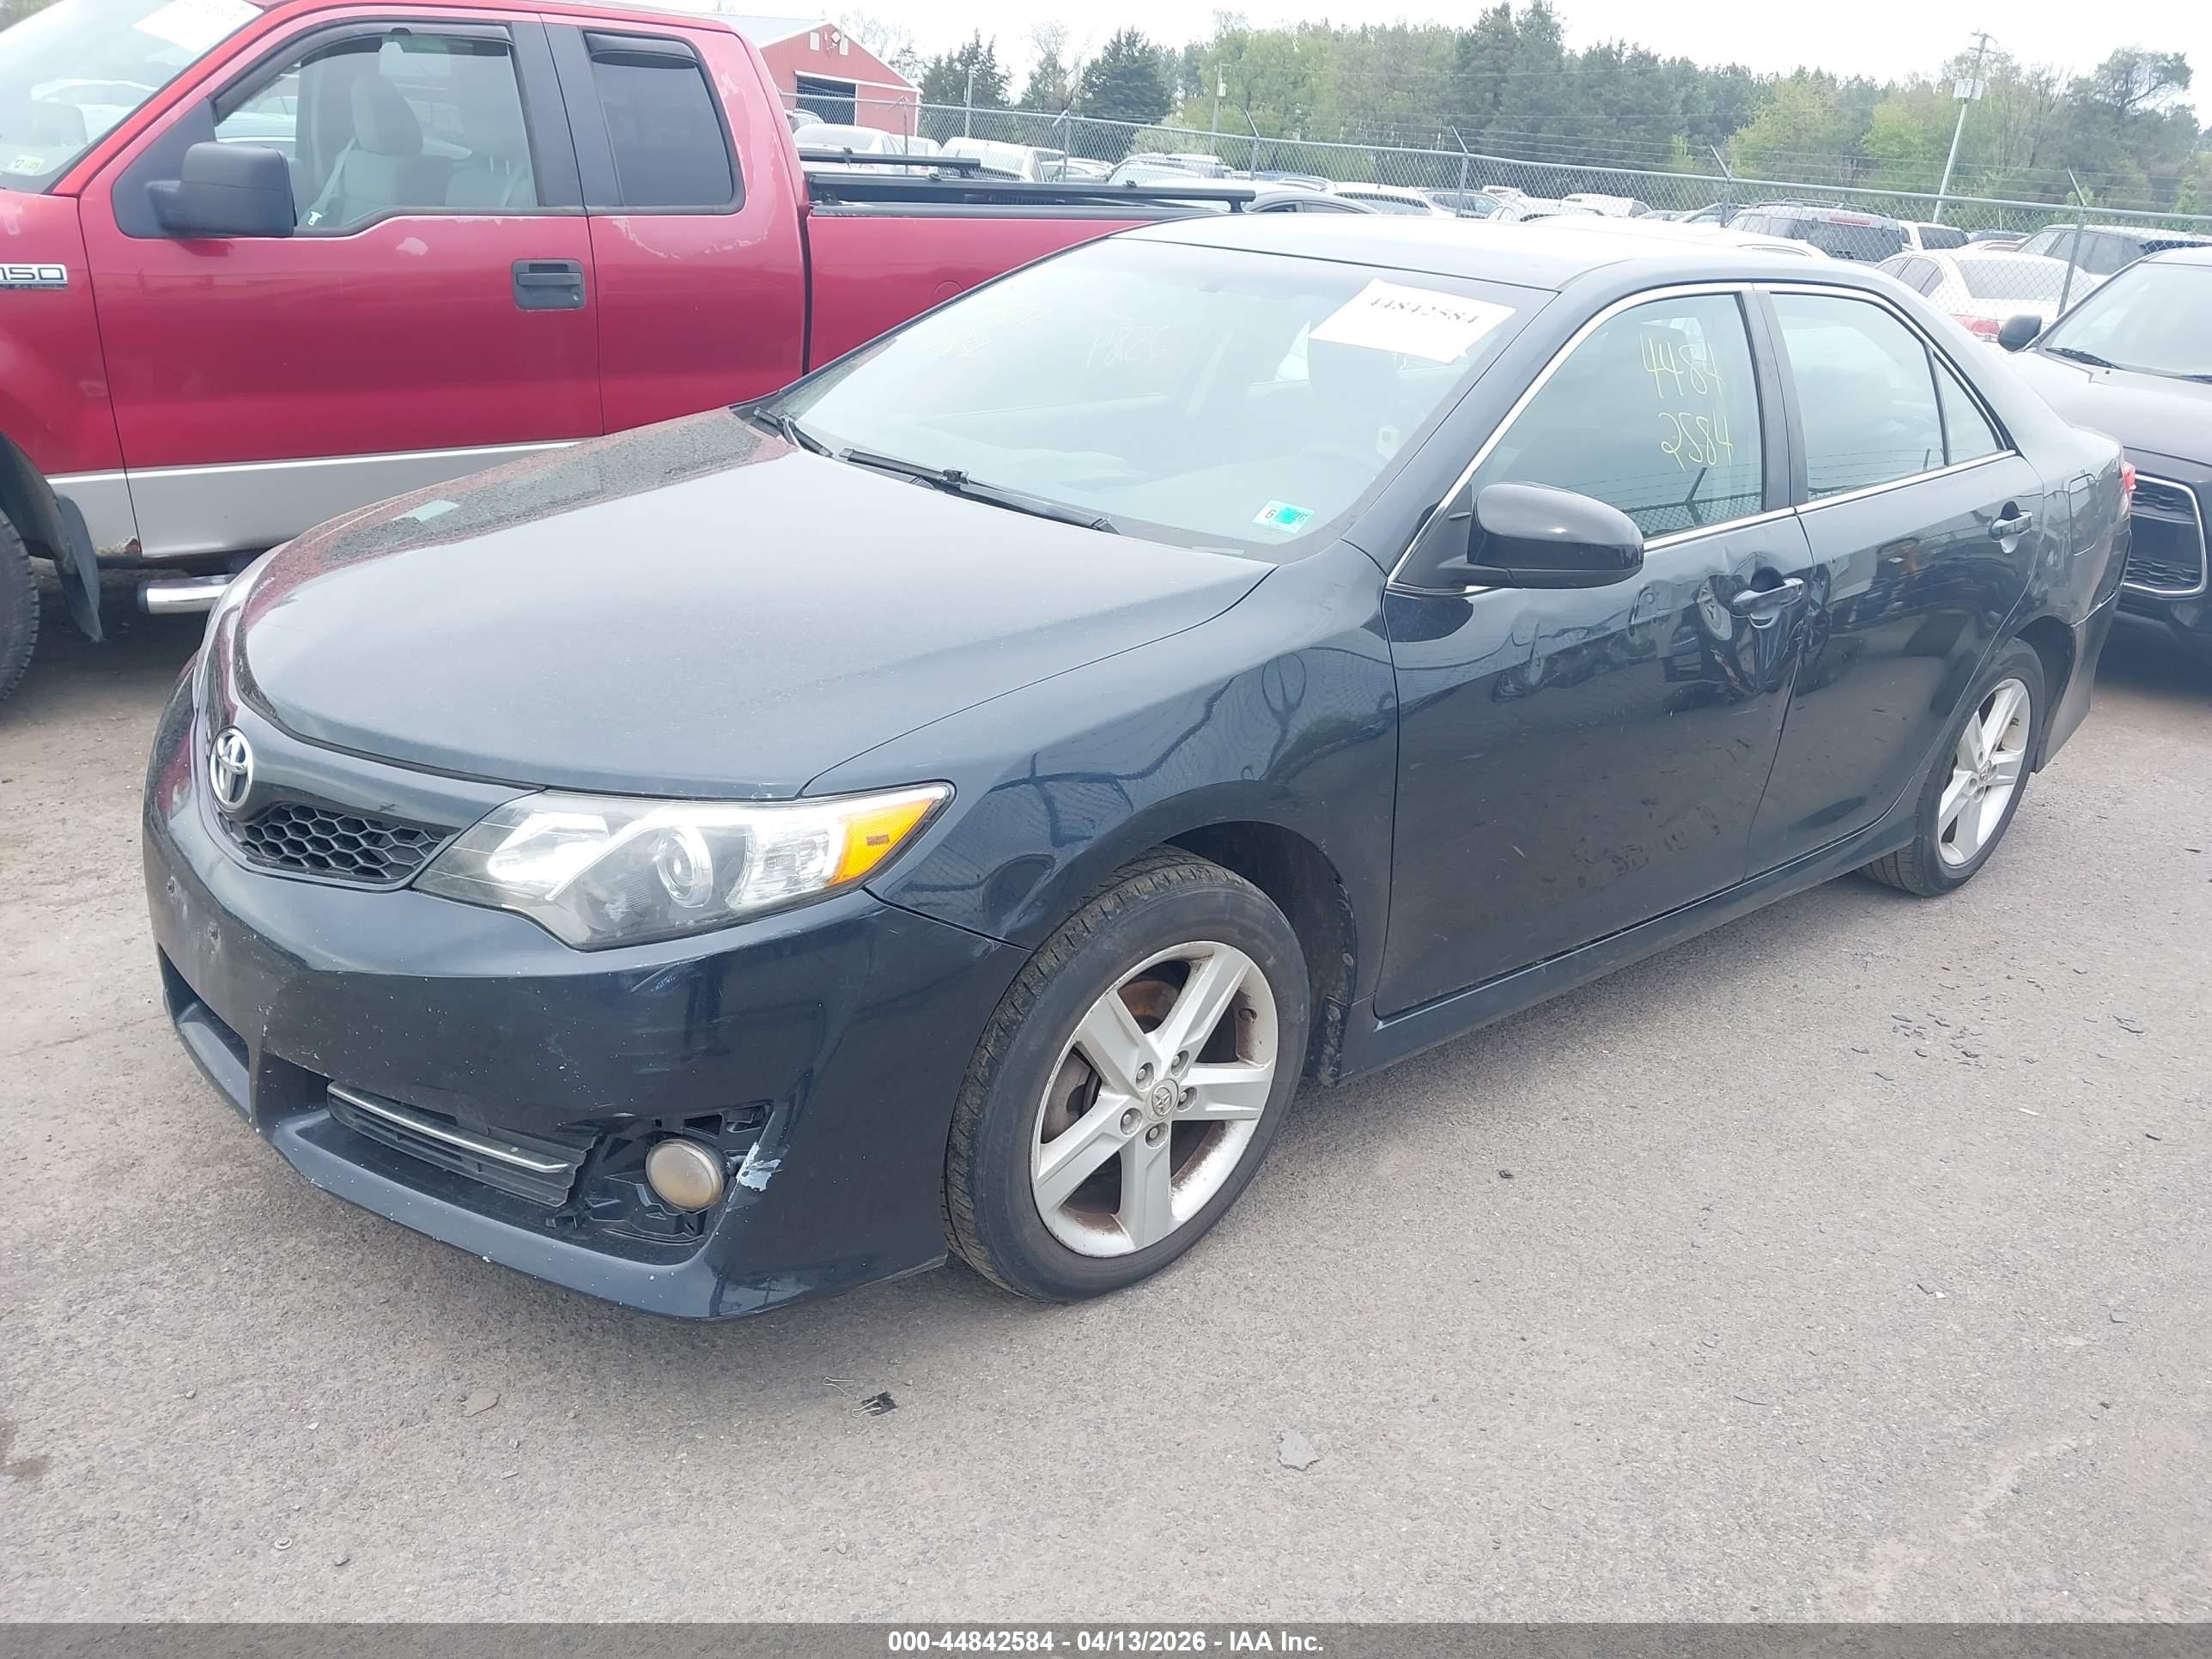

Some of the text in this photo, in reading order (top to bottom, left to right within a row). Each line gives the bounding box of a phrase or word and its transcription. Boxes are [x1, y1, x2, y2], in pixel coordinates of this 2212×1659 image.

[1638, 330, 1727, 399] 4484
[1657, 409, 1734, 472] 2584
[1264, 508, 1277, 520] 6
